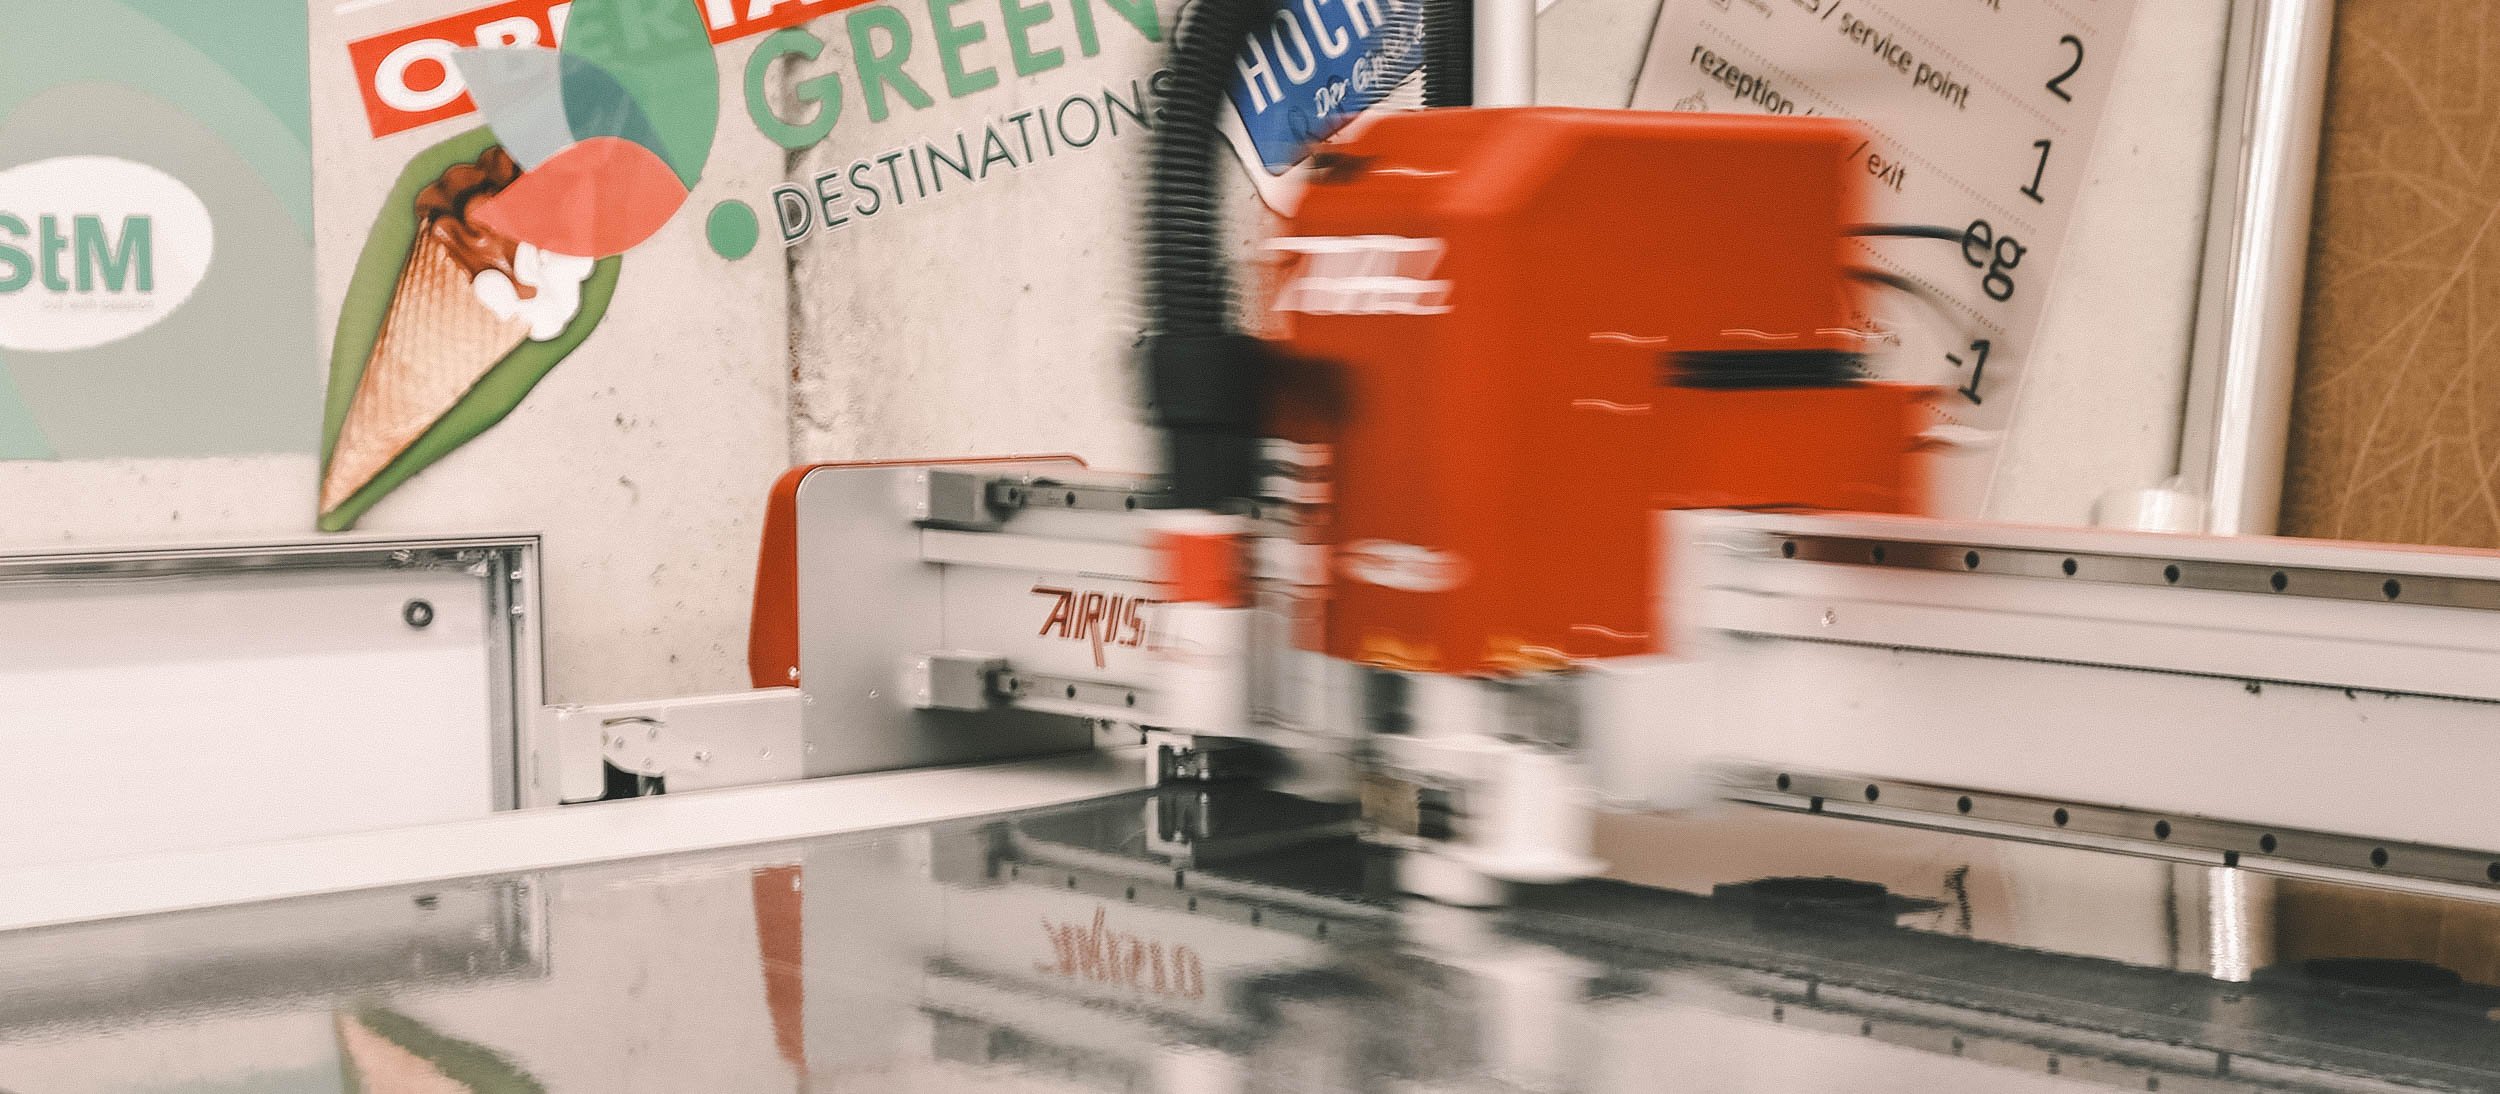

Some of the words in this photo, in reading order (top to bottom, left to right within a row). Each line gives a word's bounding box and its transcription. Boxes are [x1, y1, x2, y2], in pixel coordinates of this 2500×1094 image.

[1235, 0, 1400, 116] HOCH
[1690, 44, 1795, 115] rezeption
[1838, 11, 1914, 74] service
[1912, 62, 1973, 111] point
[2045, 34, 2084, 103] 2
[771, 67, 1178, 243] DESTINATIONS
[1867, 152, 1908, 194] exit
[2019, 139, 2051, 205] 1
[0, 212, 153, 294] StM
[1961, 218, 2028, 303] eg
[1944, 338, 1991, 406] -1
[1030, 584, 1150, 669] ARIS
